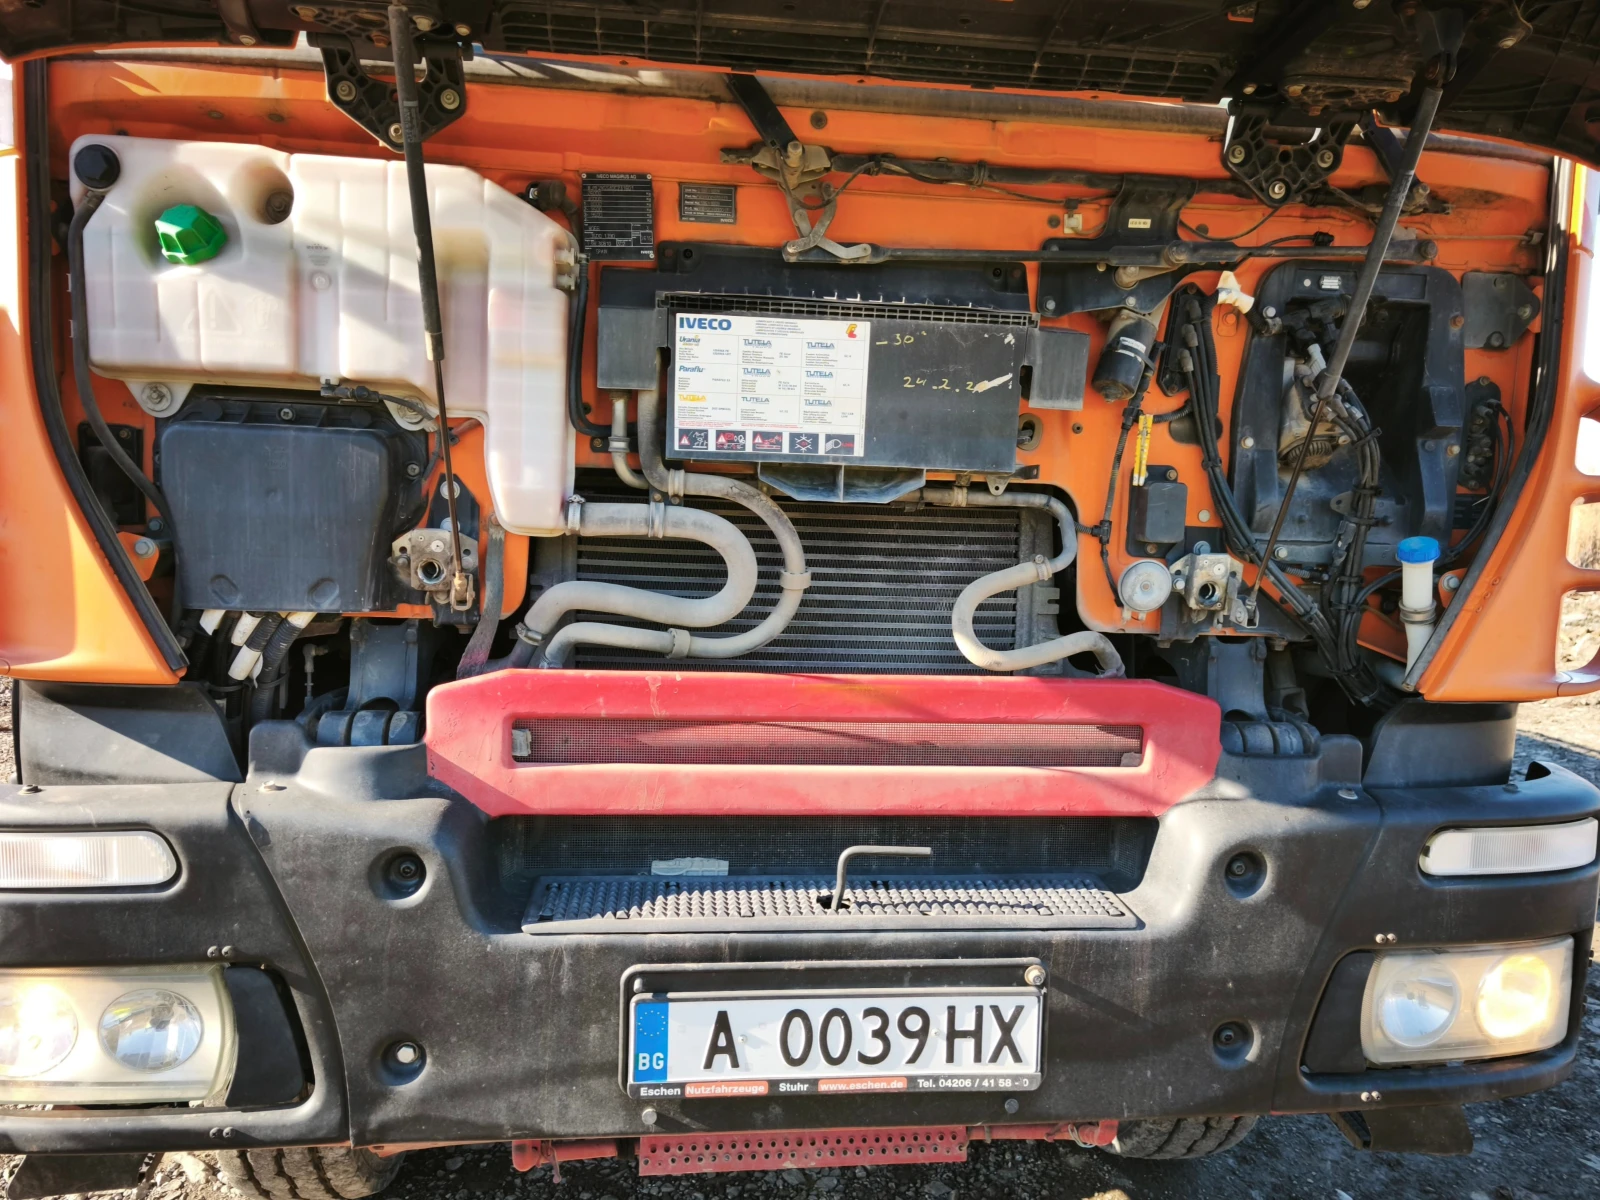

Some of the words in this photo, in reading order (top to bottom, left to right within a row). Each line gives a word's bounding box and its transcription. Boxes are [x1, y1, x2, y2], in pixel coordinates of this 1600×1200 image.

[679, 316, 732, 331] IVECO
[678, 365, 704, 373] Paraflu
[703, 1010, 740, 1070] A
[779, 1005, 931, 1068] 0039
[946, 1004, 1025, 1064] HX
[638, 1052, 664, 1071] BG
[640, 1086, 681, 1096] Eschen
[686, 1084, 765, 1096] Nutzfahrzeuge
[779, 1082, 809, 1092] Stuhr
[820, 1079, 904, 1092] www.eschen.de
[917, 1079, 936, 1088] Tel.
[938, 1078, 972, 1088] 04206
